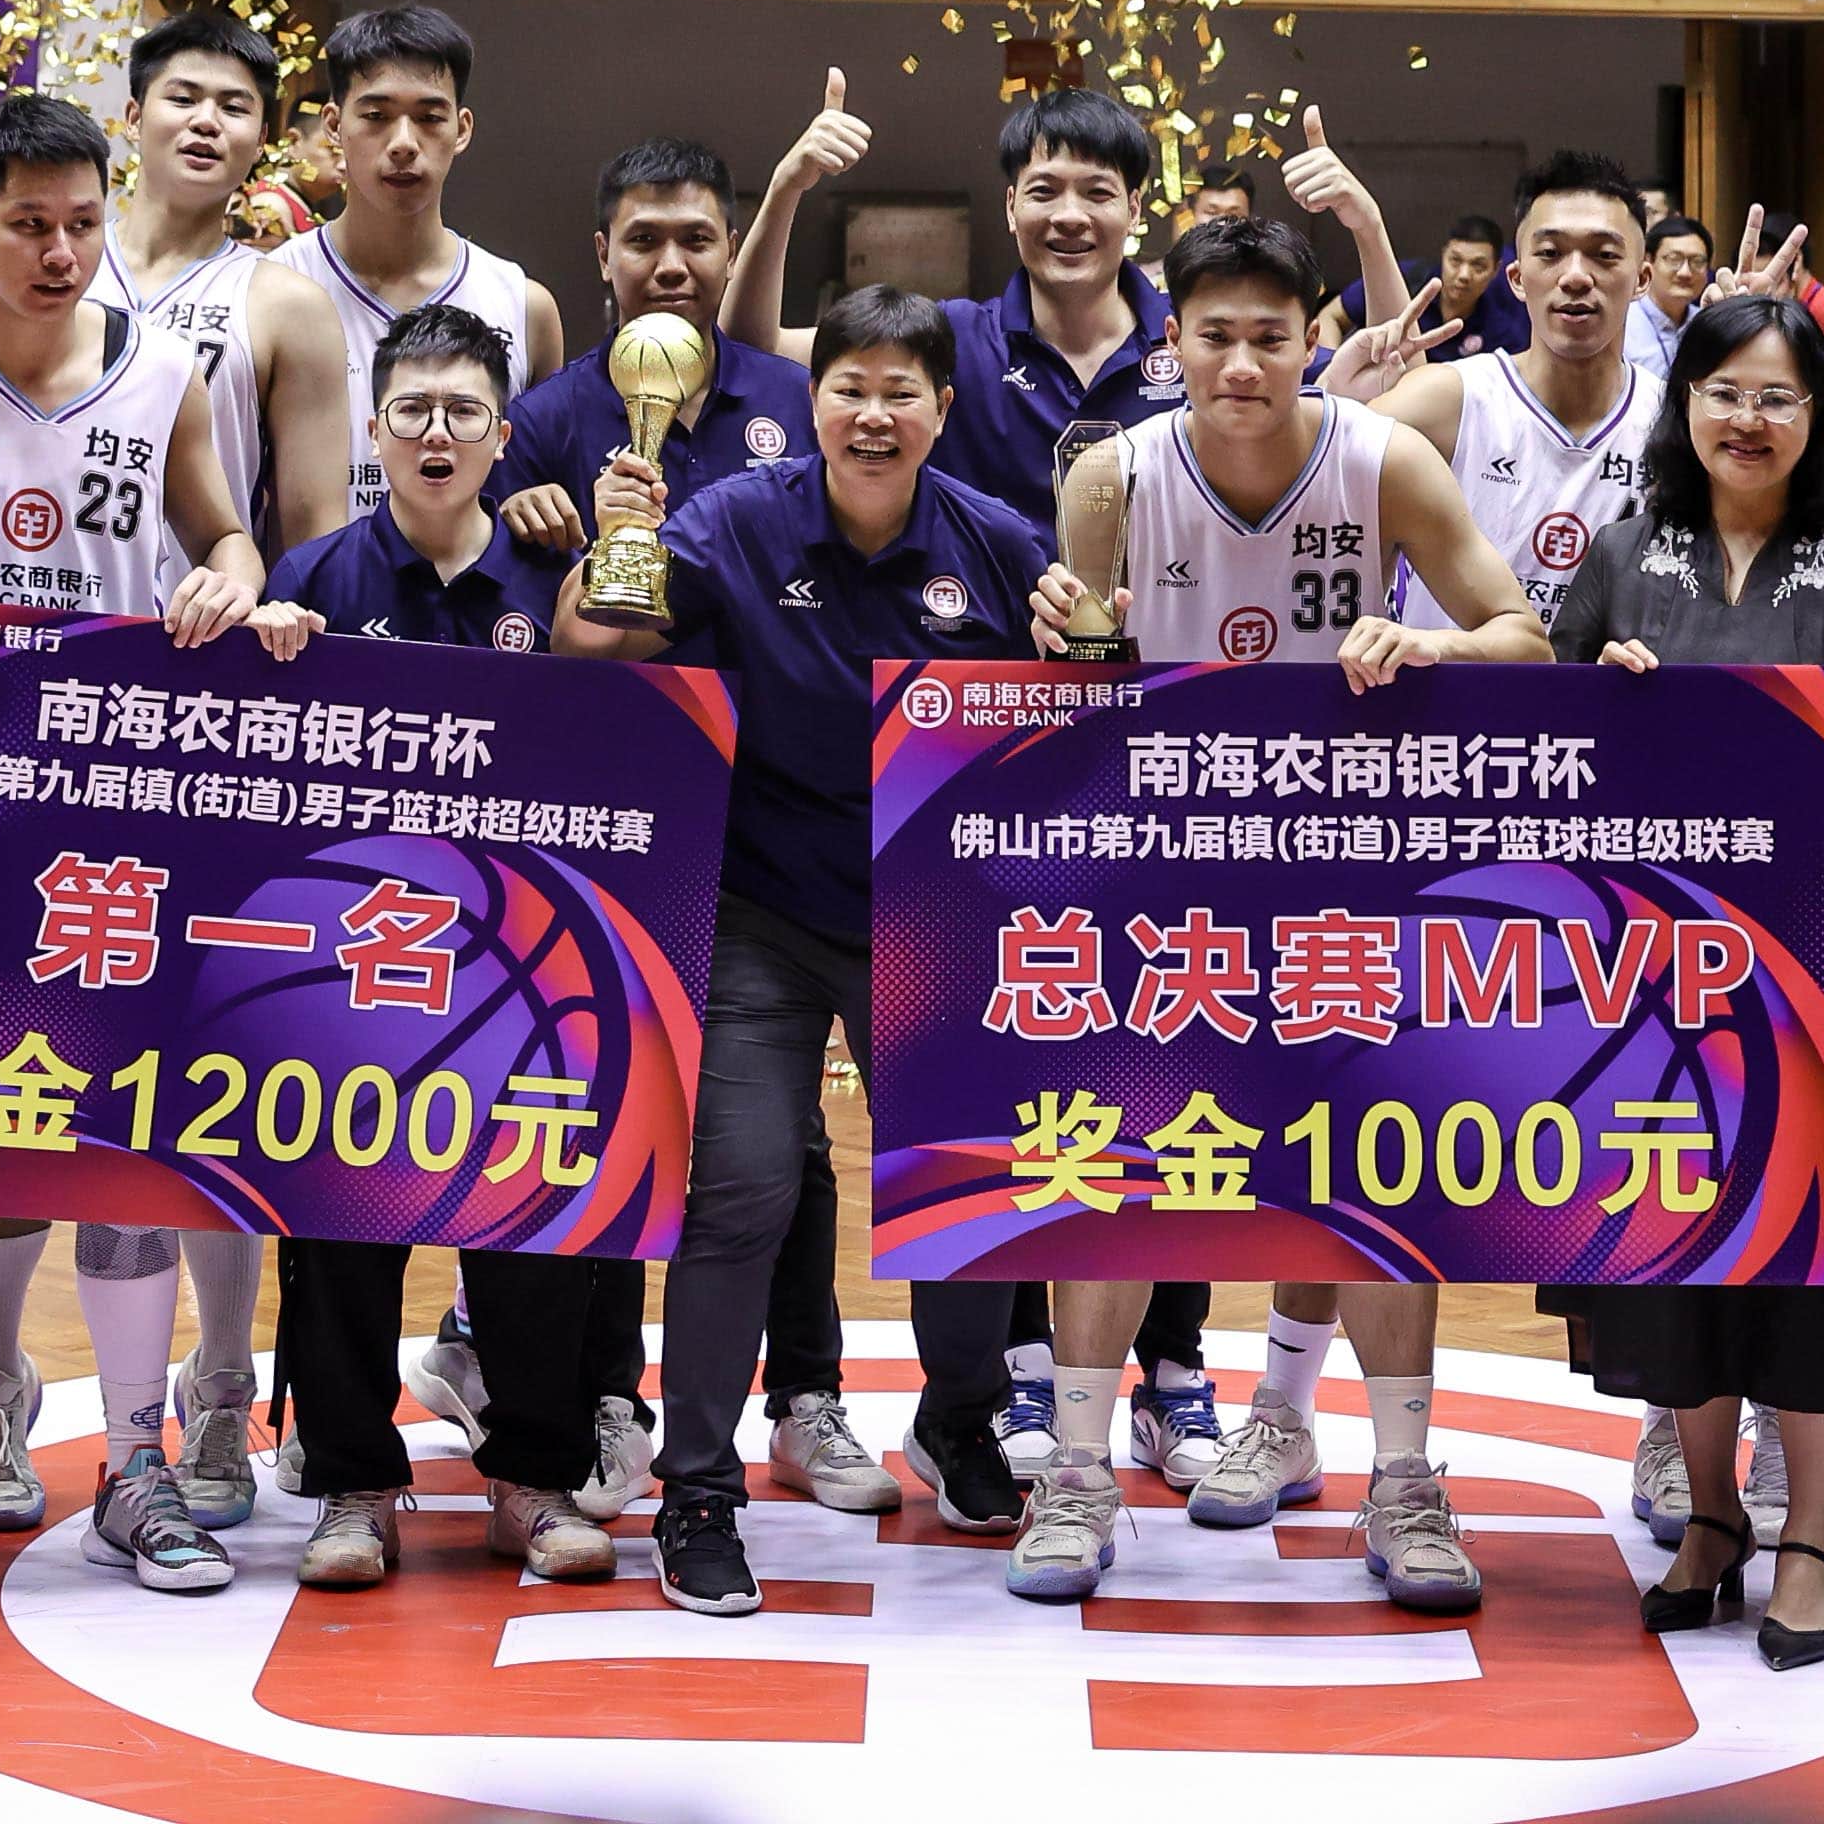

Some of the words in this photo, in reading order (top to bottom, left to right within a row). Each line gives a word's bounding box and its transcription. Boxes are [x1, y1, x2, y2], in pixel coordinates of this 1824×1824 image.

[83, 425, 154, 475] 均安
[1480, 471, 1522, 487] CYNDICAT
[73, 468, 145, 543] 23
[1291, 522, 1365, 560] 均安
[1156, 578, 1200, 588] CYNDICAT
[1291, 568, 1363, 634] 33
[962, 680, 1145, 711] 南海农商银行
[962, 707, 1011, 728] NRC
[1014, 707, 1075, 729] BANK
[37, 677, 497, 782] 南海农商银行杯
[1126, 731, 1598, 802] 南海农商银行杯
[950, 812, 1776, 867] 佛山市第九届镇(街道)男子篮球超级联赛
[26, 850, 464, 1017] 第一名
[982, 905, 1757, 1047] 总决赛MVP
[1008, 1090, 1721, 1218] 奖金1000元
